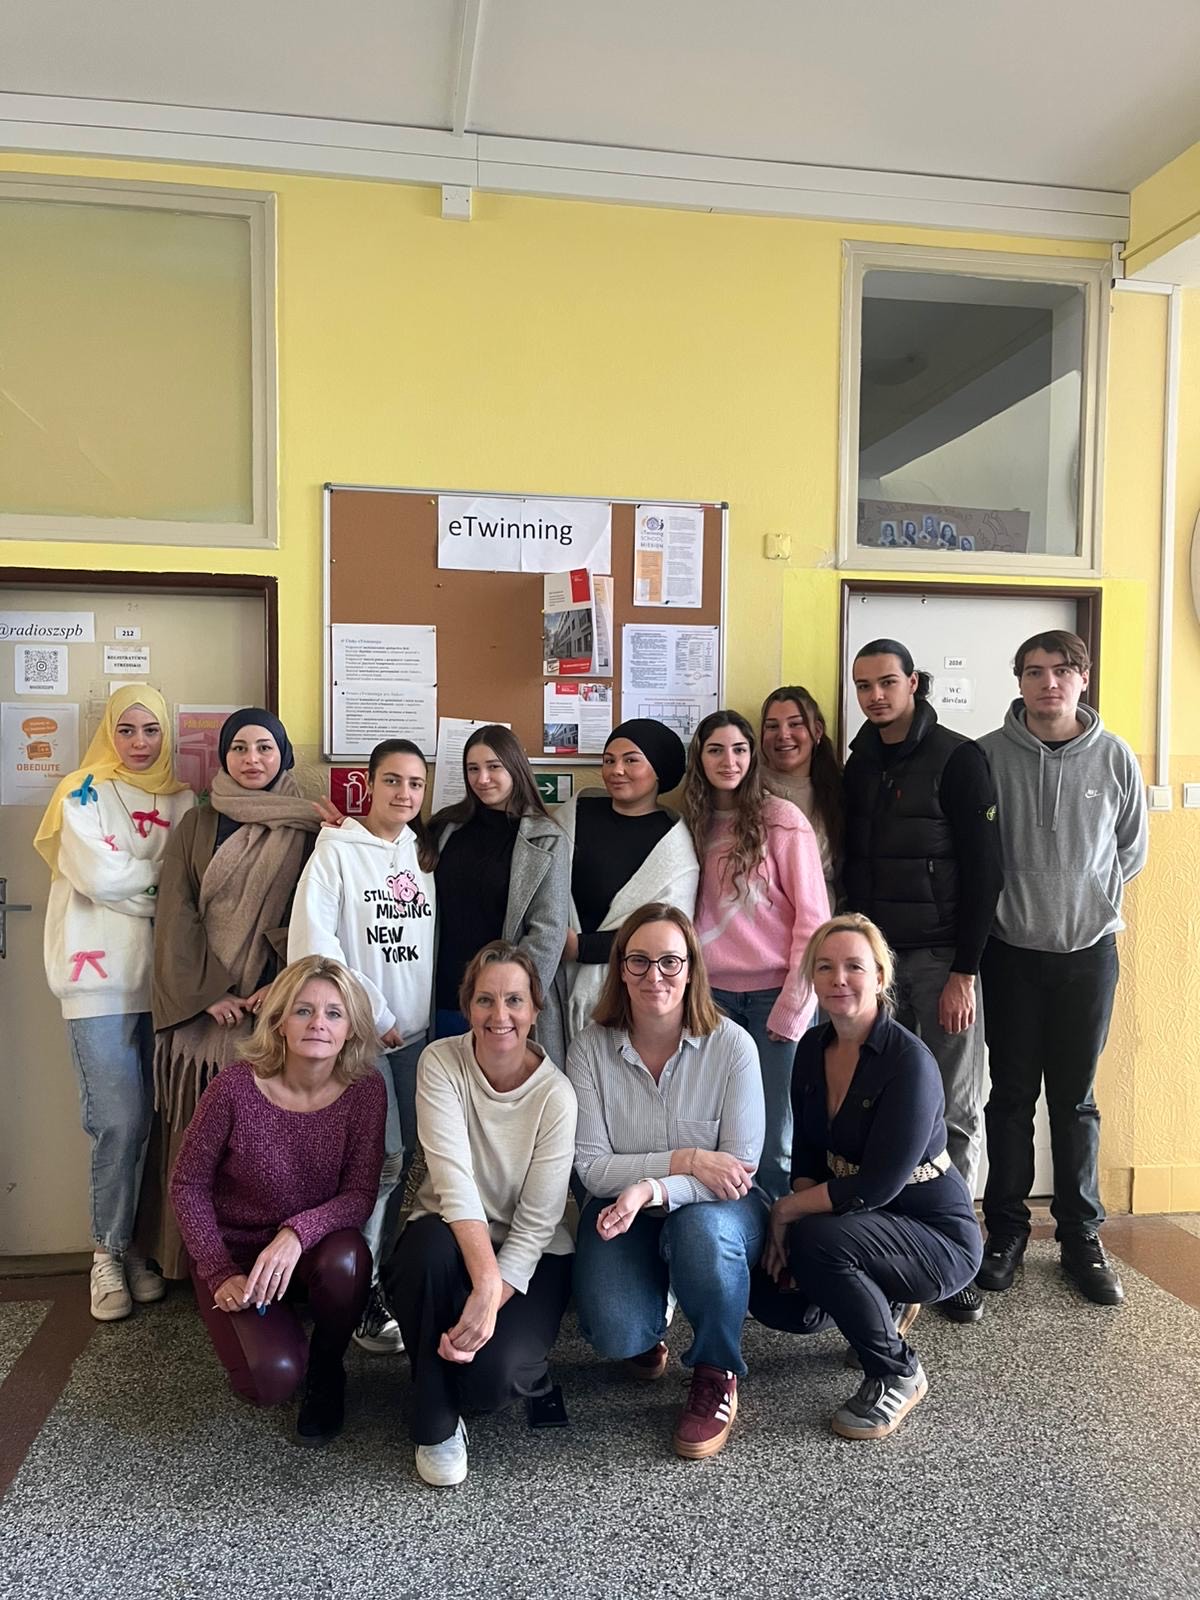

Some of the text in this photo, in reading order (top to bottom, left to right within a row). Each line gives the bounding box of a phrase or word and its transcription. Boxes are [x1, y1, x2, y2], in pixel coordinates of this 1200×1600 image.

[449, 516, 573, 546] eTwinning
[0, 623, 84, 639] @radioszspb
[16, 762, 60, 772] OBEDUJTE
[364, 888, 393, 902] STILL
[366, 925, 404, 945] NEW
[382, 945, 419, 963] YORK
